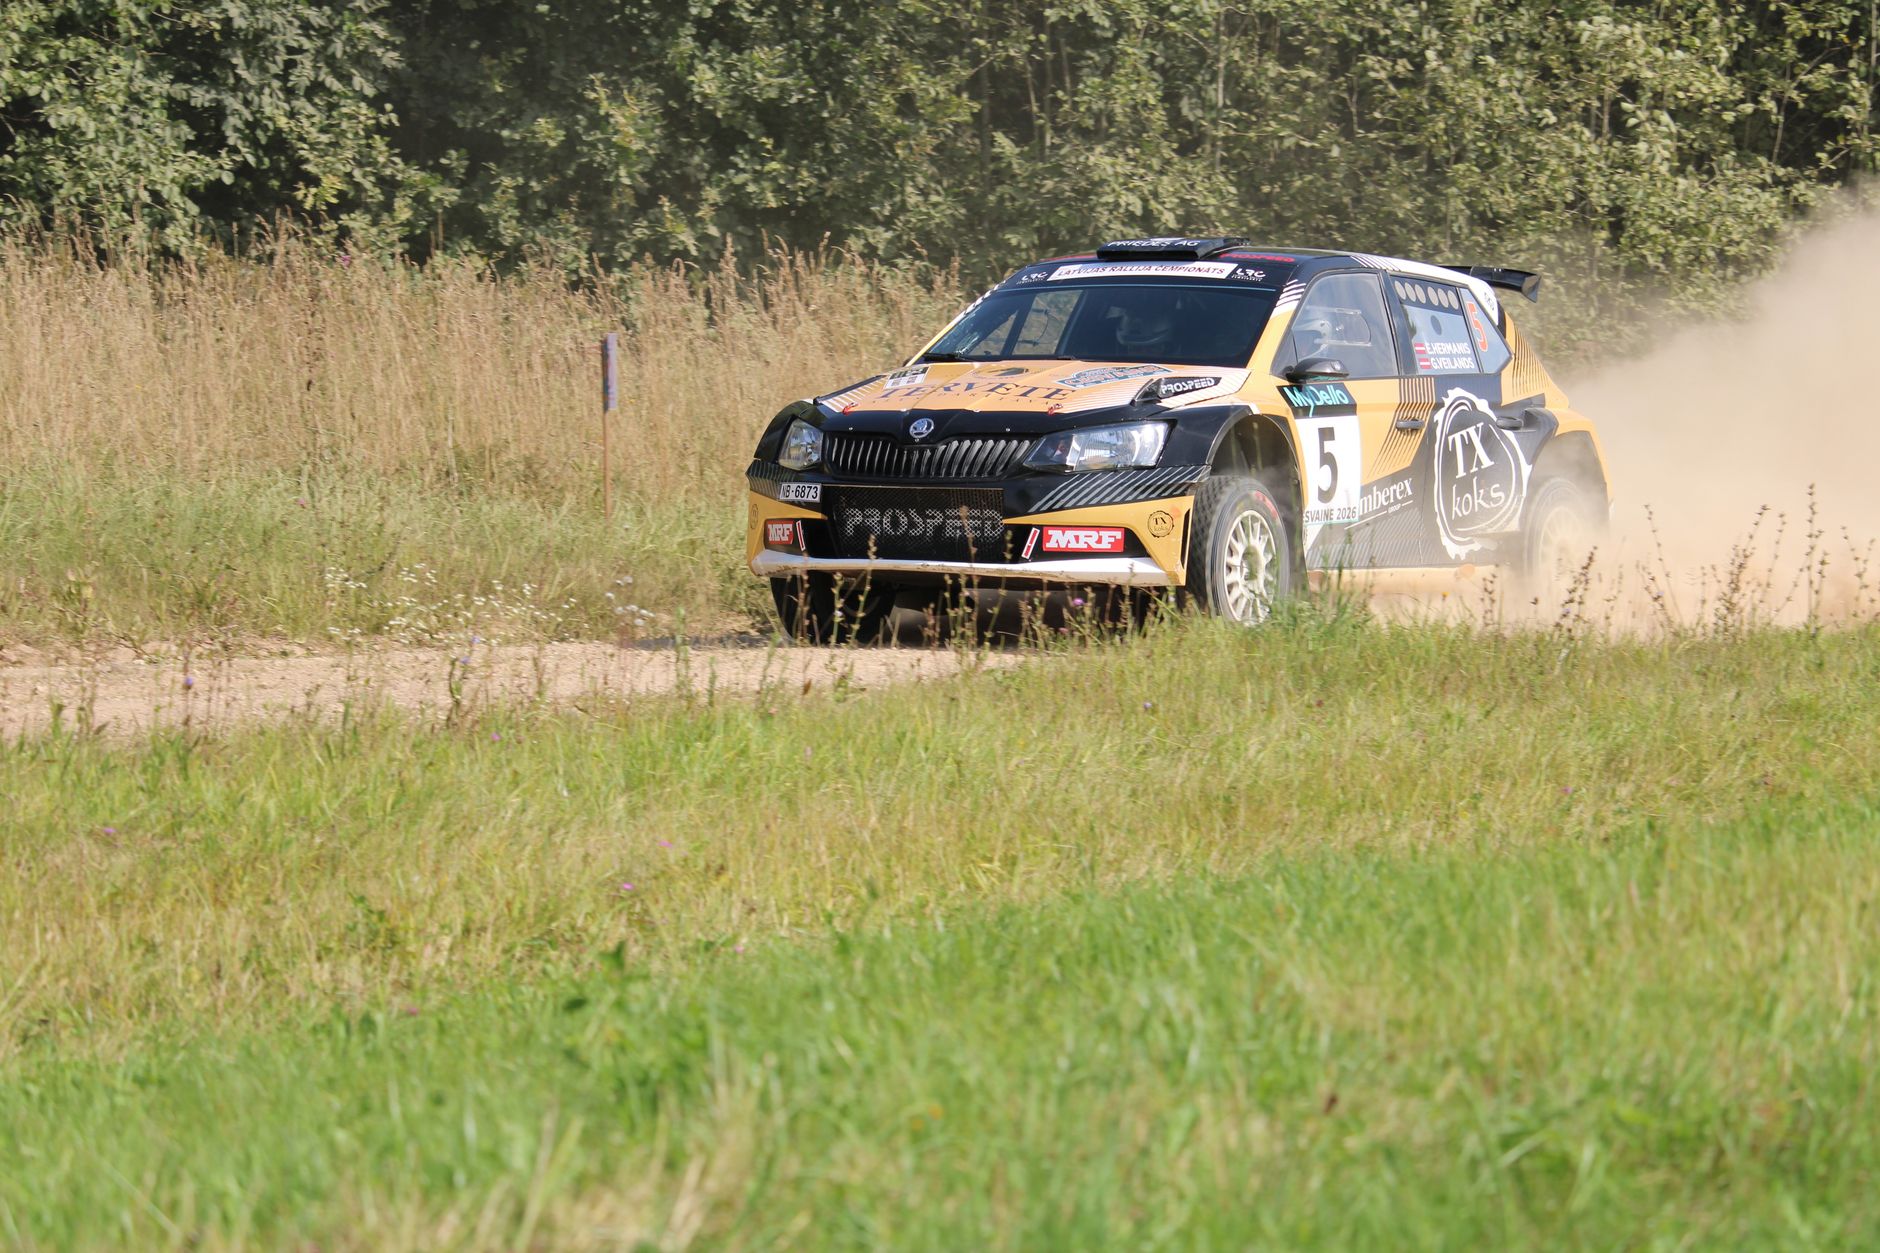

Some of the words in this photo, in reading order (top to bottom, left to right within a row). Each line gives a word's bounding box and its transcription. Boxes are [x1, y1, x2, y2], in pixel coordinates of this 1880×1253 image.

[1058, 265, 1107, 276] LATVIJAS
[1110, 265, 1151, 273] RALLIJA
[1467, 302, 1489, 352] 5
[1426, 342, 1471, 354] E.HERMANIS
[1160, 377, 1216, 395] PROSPEED
[1284, 385, 1349, 417] MyDello
[1448, 422, 1494, 478] TX
[1317, 426, 1338, 504] 5
[1452, 476, 1505, 520] koks
[845, 508, 1003, 537] PROSPEED
[1303, 508, 1334, 523] SVAINE
[1336, 507, 1357, 520] 2026
[768, 523, 792, 542] MRF
[1046, 529, 1122, 549] MRF
